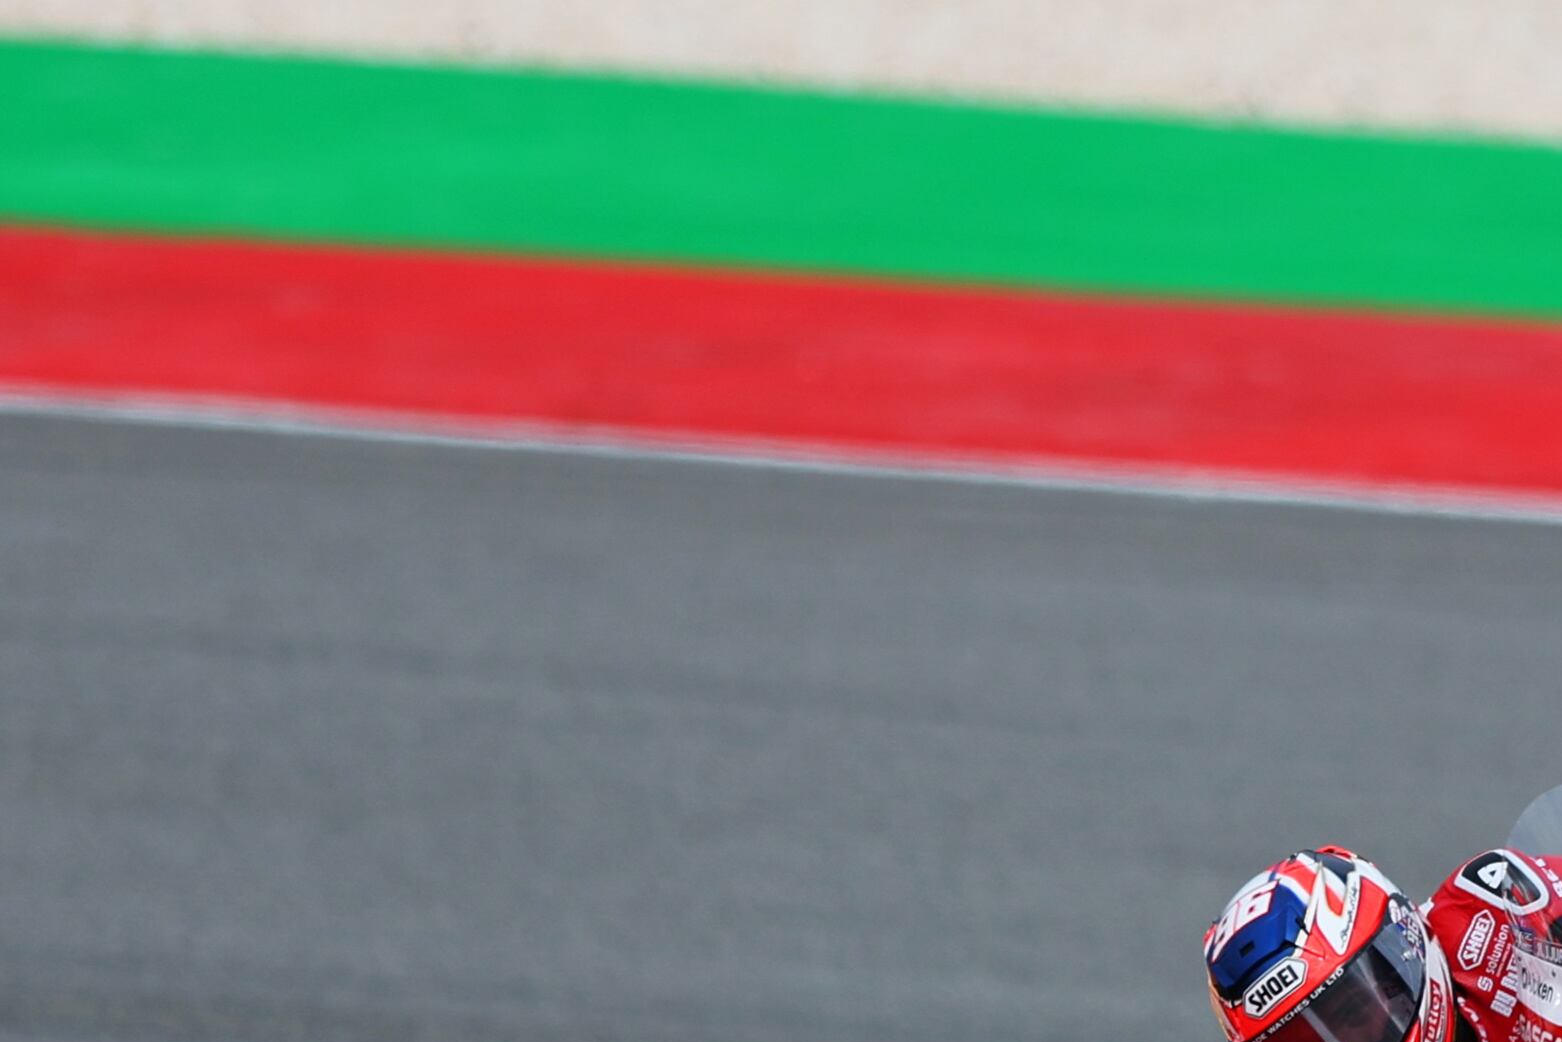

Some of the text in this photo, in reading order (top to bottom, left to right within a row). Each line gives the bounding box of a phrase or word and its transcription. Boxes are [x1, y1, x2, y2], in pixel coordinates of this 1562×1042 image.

[1463, 917, 1490, 963] SHOEI
[1485, 923, 1510, 975] solunion
[1247, 965, 1300, 1013] SHOEI
[1267, 1000, 1311, 1033] WATCHES
[1310, 983, 1329, 1002] UK
[1326, 967, 1345, 987] LTD
